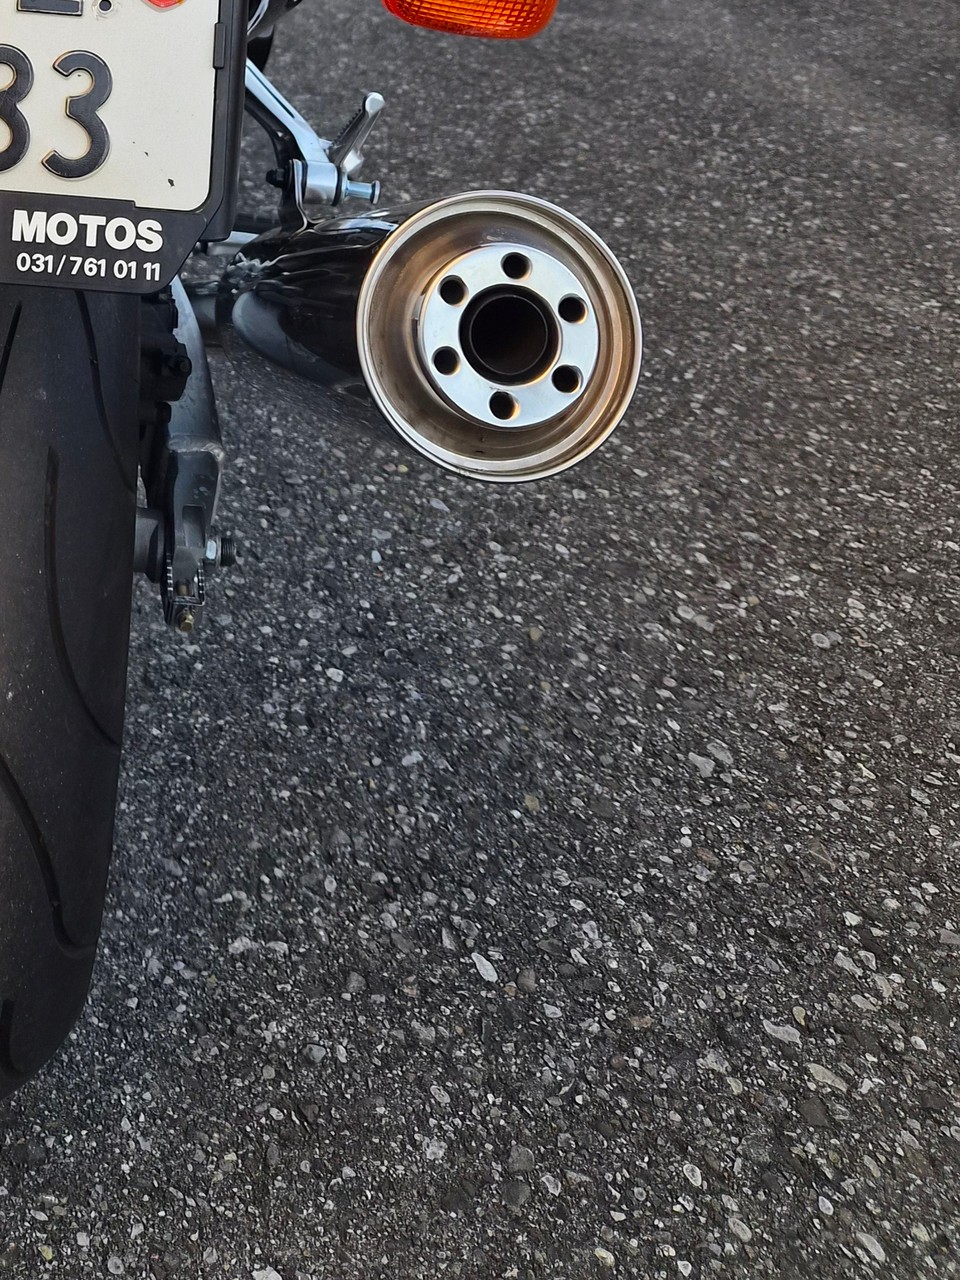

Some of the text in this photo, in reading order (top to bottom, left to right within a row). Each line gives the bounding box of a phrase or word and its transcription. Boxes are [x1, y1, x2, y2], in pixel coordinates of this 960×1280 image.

[11, 208, 164, 253] MOTOS
[16, 252, 107, 278] 031/761
[113, 259, 138, 280] 01
[142, 261, 162, 282] 11
